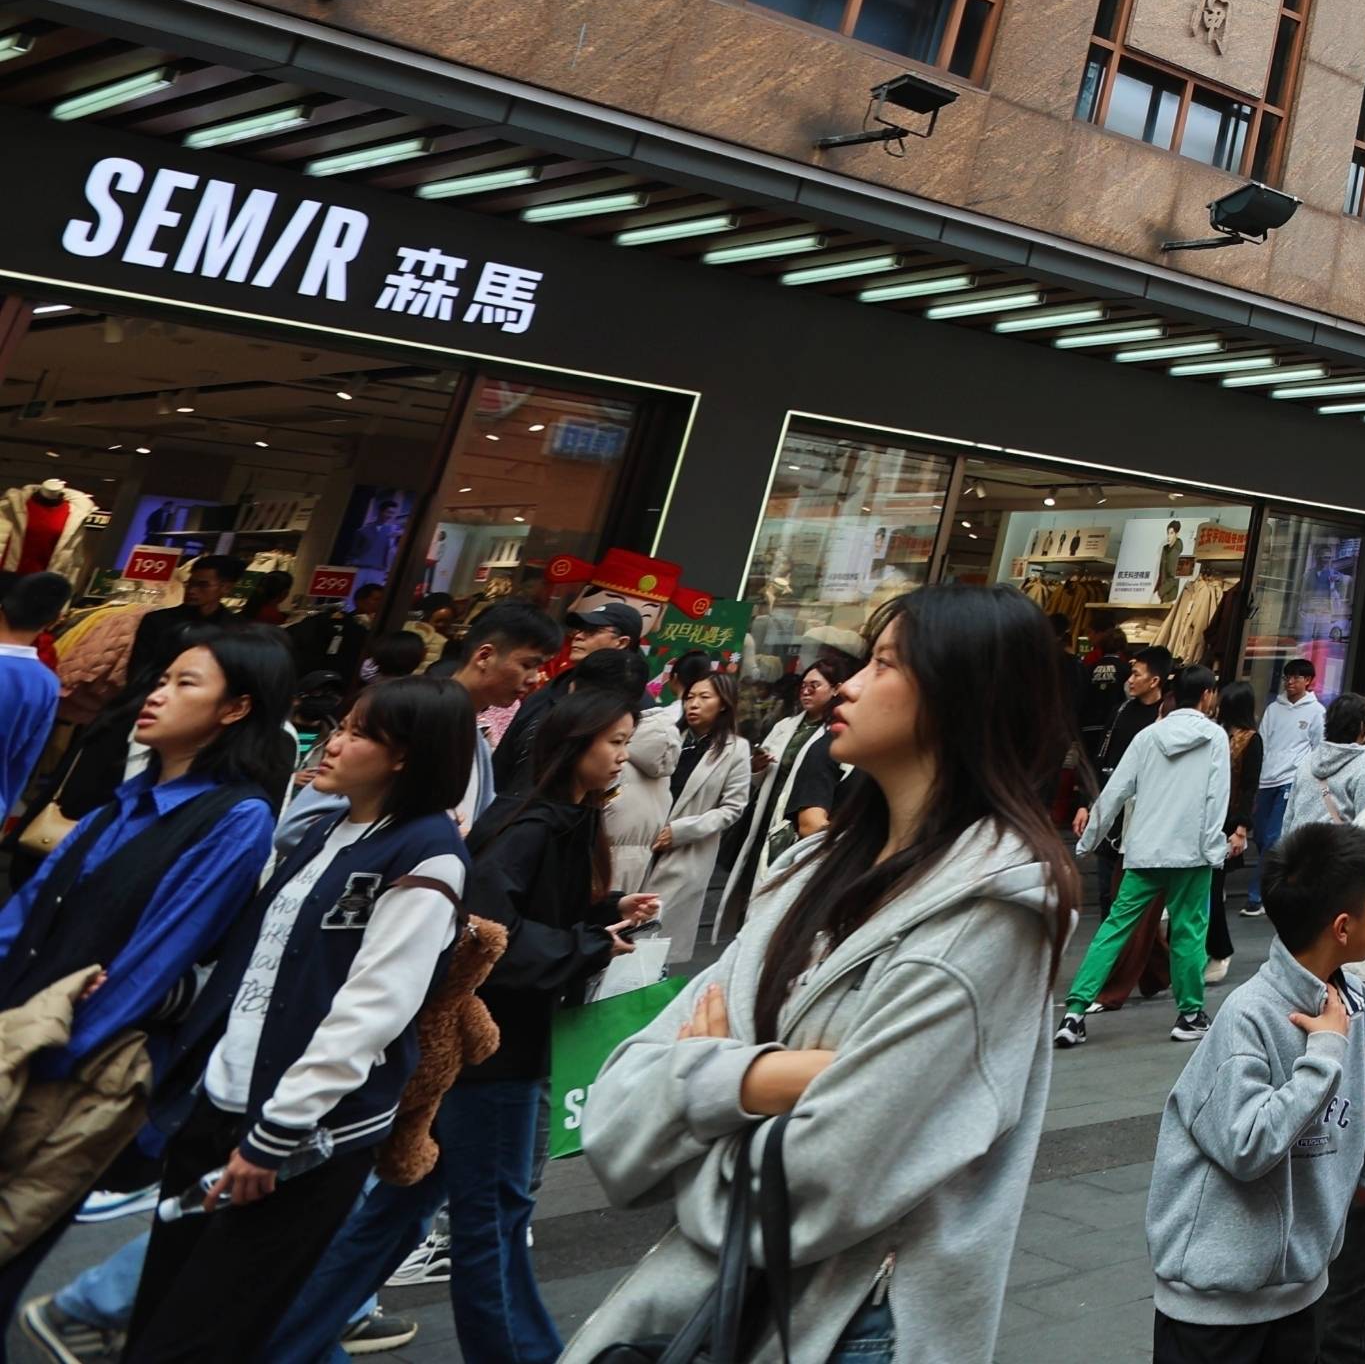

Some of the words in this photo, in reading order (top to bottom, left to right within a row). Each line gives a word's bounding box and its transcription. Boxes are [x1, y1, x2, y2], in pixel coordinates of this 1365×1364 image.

[374, 246, 545, 336] 森馬
[132, 557, 168, 575] 199
[316, 576, 350, 592] 299
